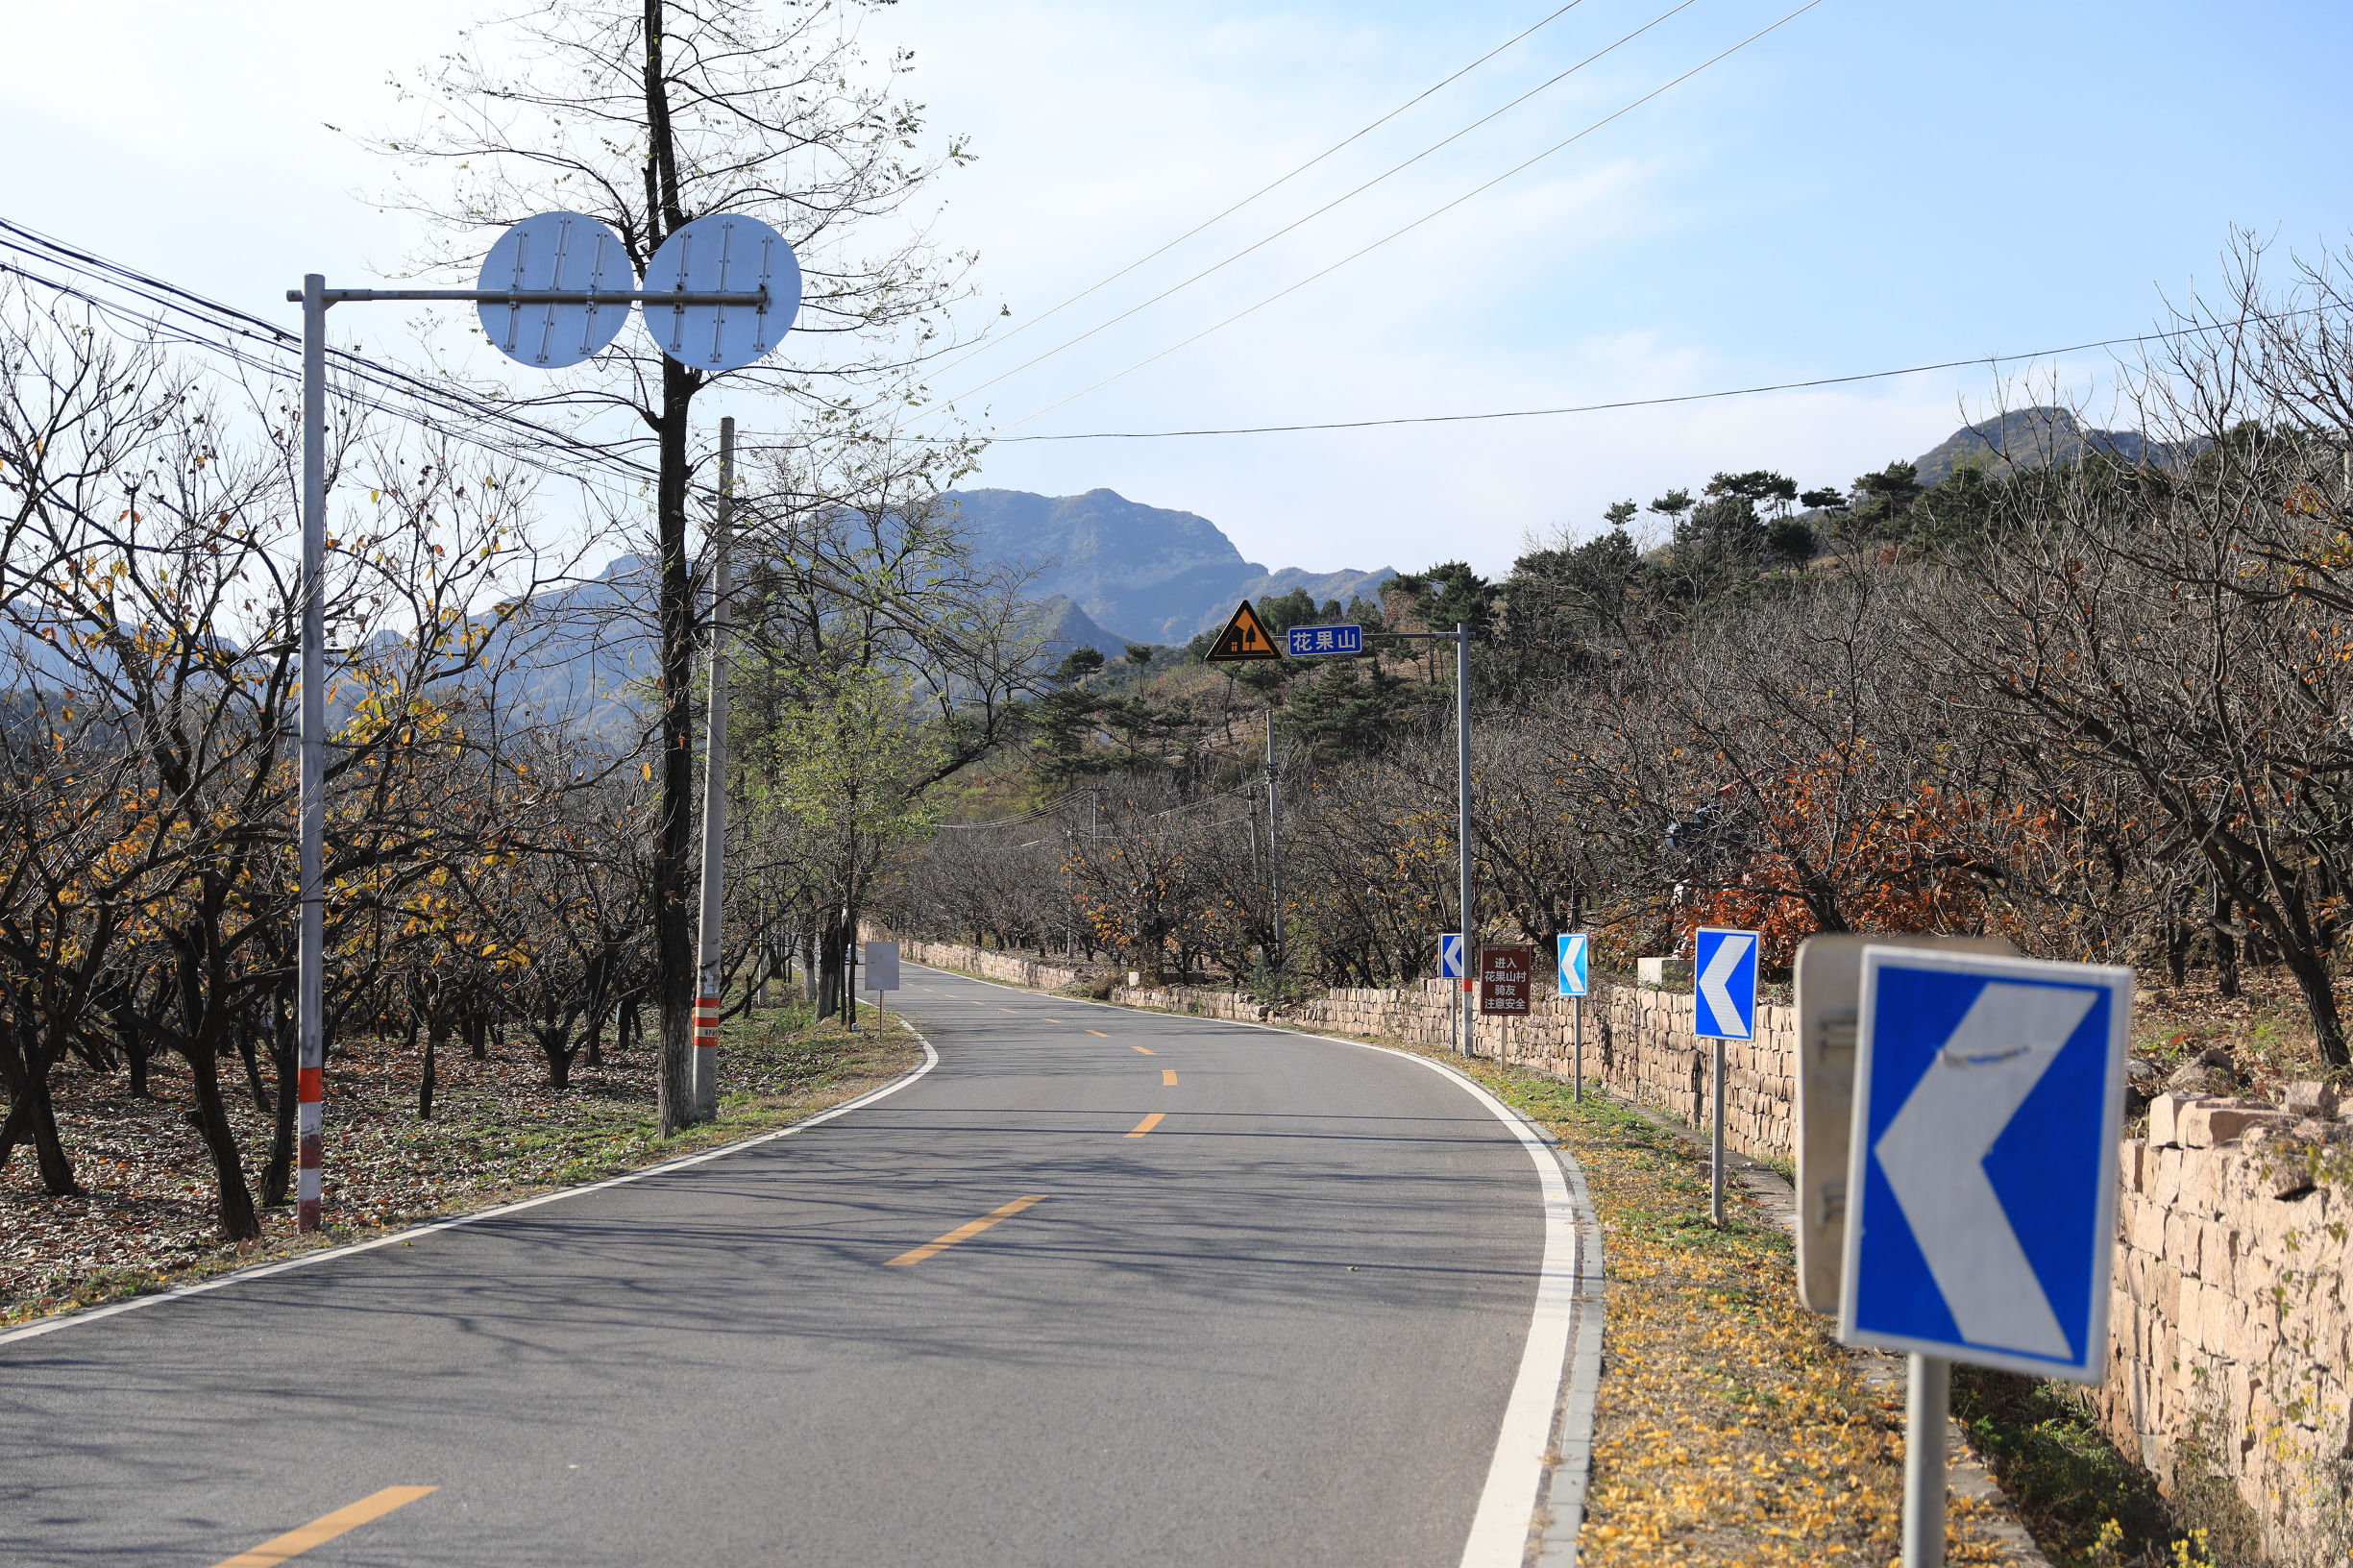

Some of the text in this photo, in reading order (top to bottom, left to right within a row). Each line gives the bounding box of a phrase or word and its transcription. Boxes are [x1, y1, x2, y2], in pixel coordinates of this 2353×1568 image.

[1292, 630, 1356, 651] 花果山
[1494, 957, 1517, 968] 进入
[1484, 970, 1527, 983] 花果山村
[1494, 985, 1516, 995] 骑友
[1484, 998, 1526, 1010] 注意安全
